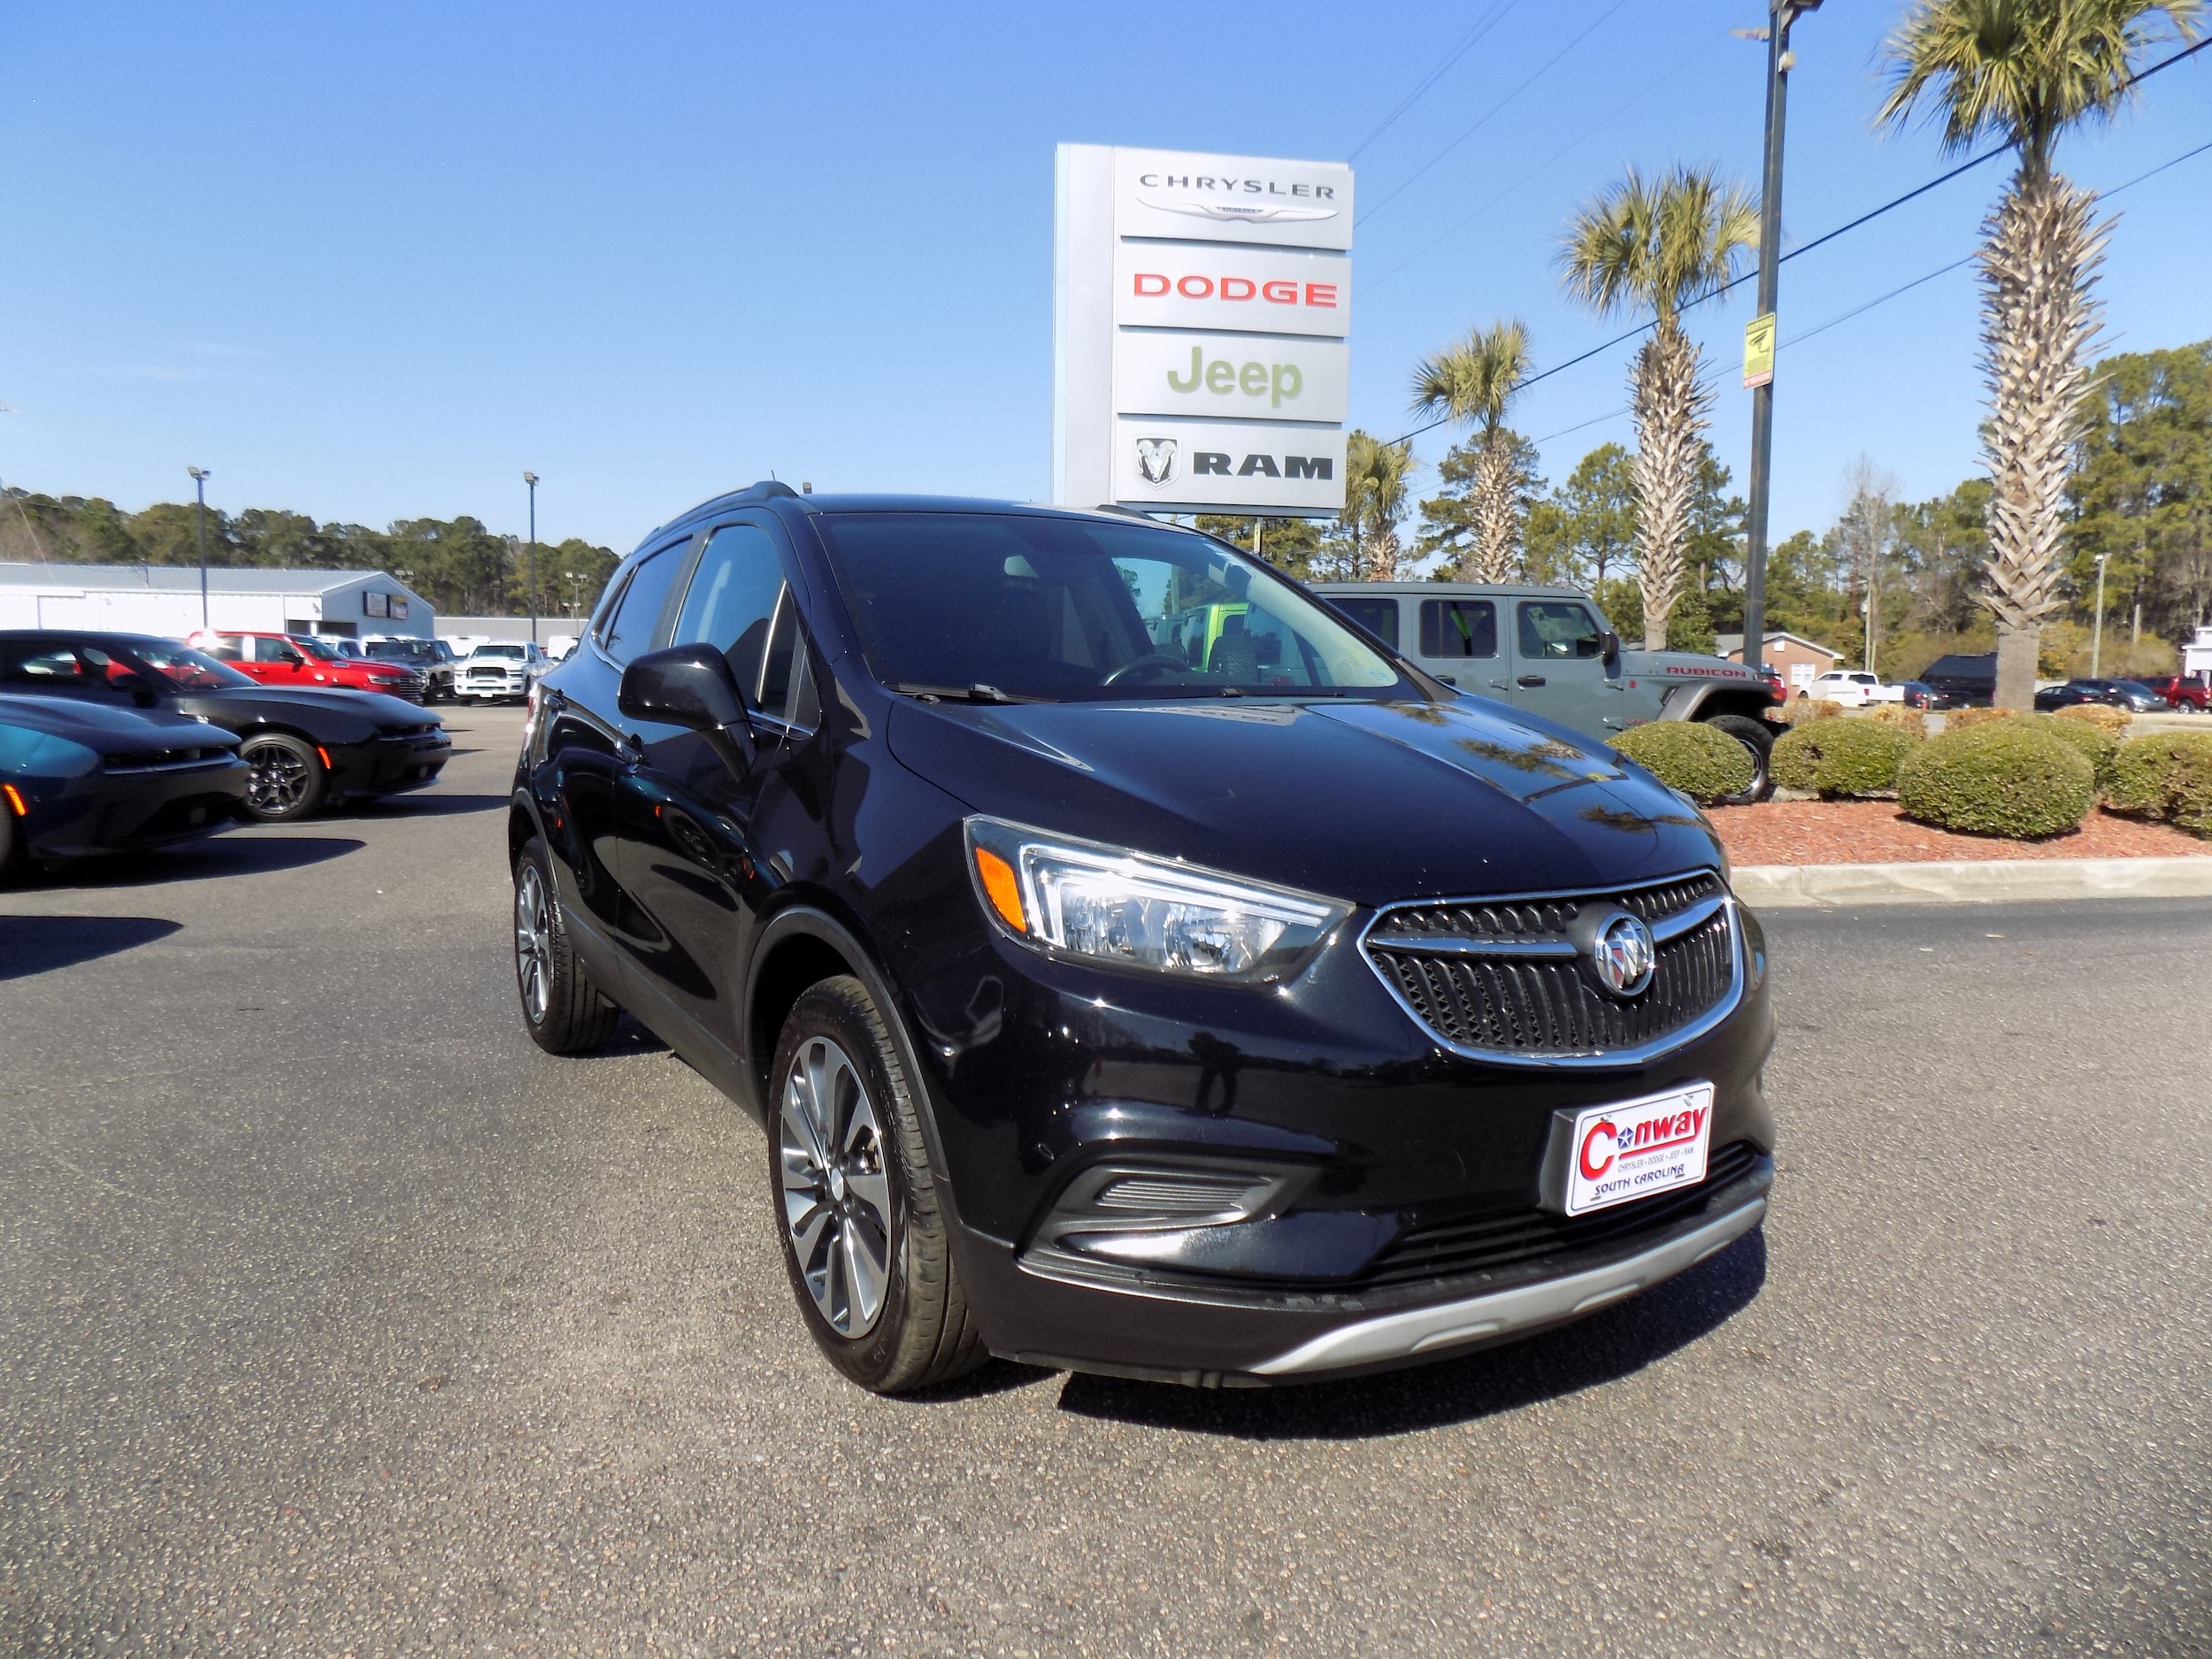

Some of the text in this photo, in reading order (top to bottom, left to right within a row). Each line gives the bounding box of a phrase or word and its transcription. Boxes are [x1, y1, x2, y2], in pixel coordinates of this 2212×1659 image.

[1140, 173, 1334, 200] CHRYSLER
[1133, 273, 1338, 309] DODGE
[1167, 346, 1302, 408] Jeep
[1193, 452, 1333, 480] RAM
[1665, 666, 1747, 678] RUBICON
[1595, 1164, 1685, 1194] SOUTH CAROLINA
